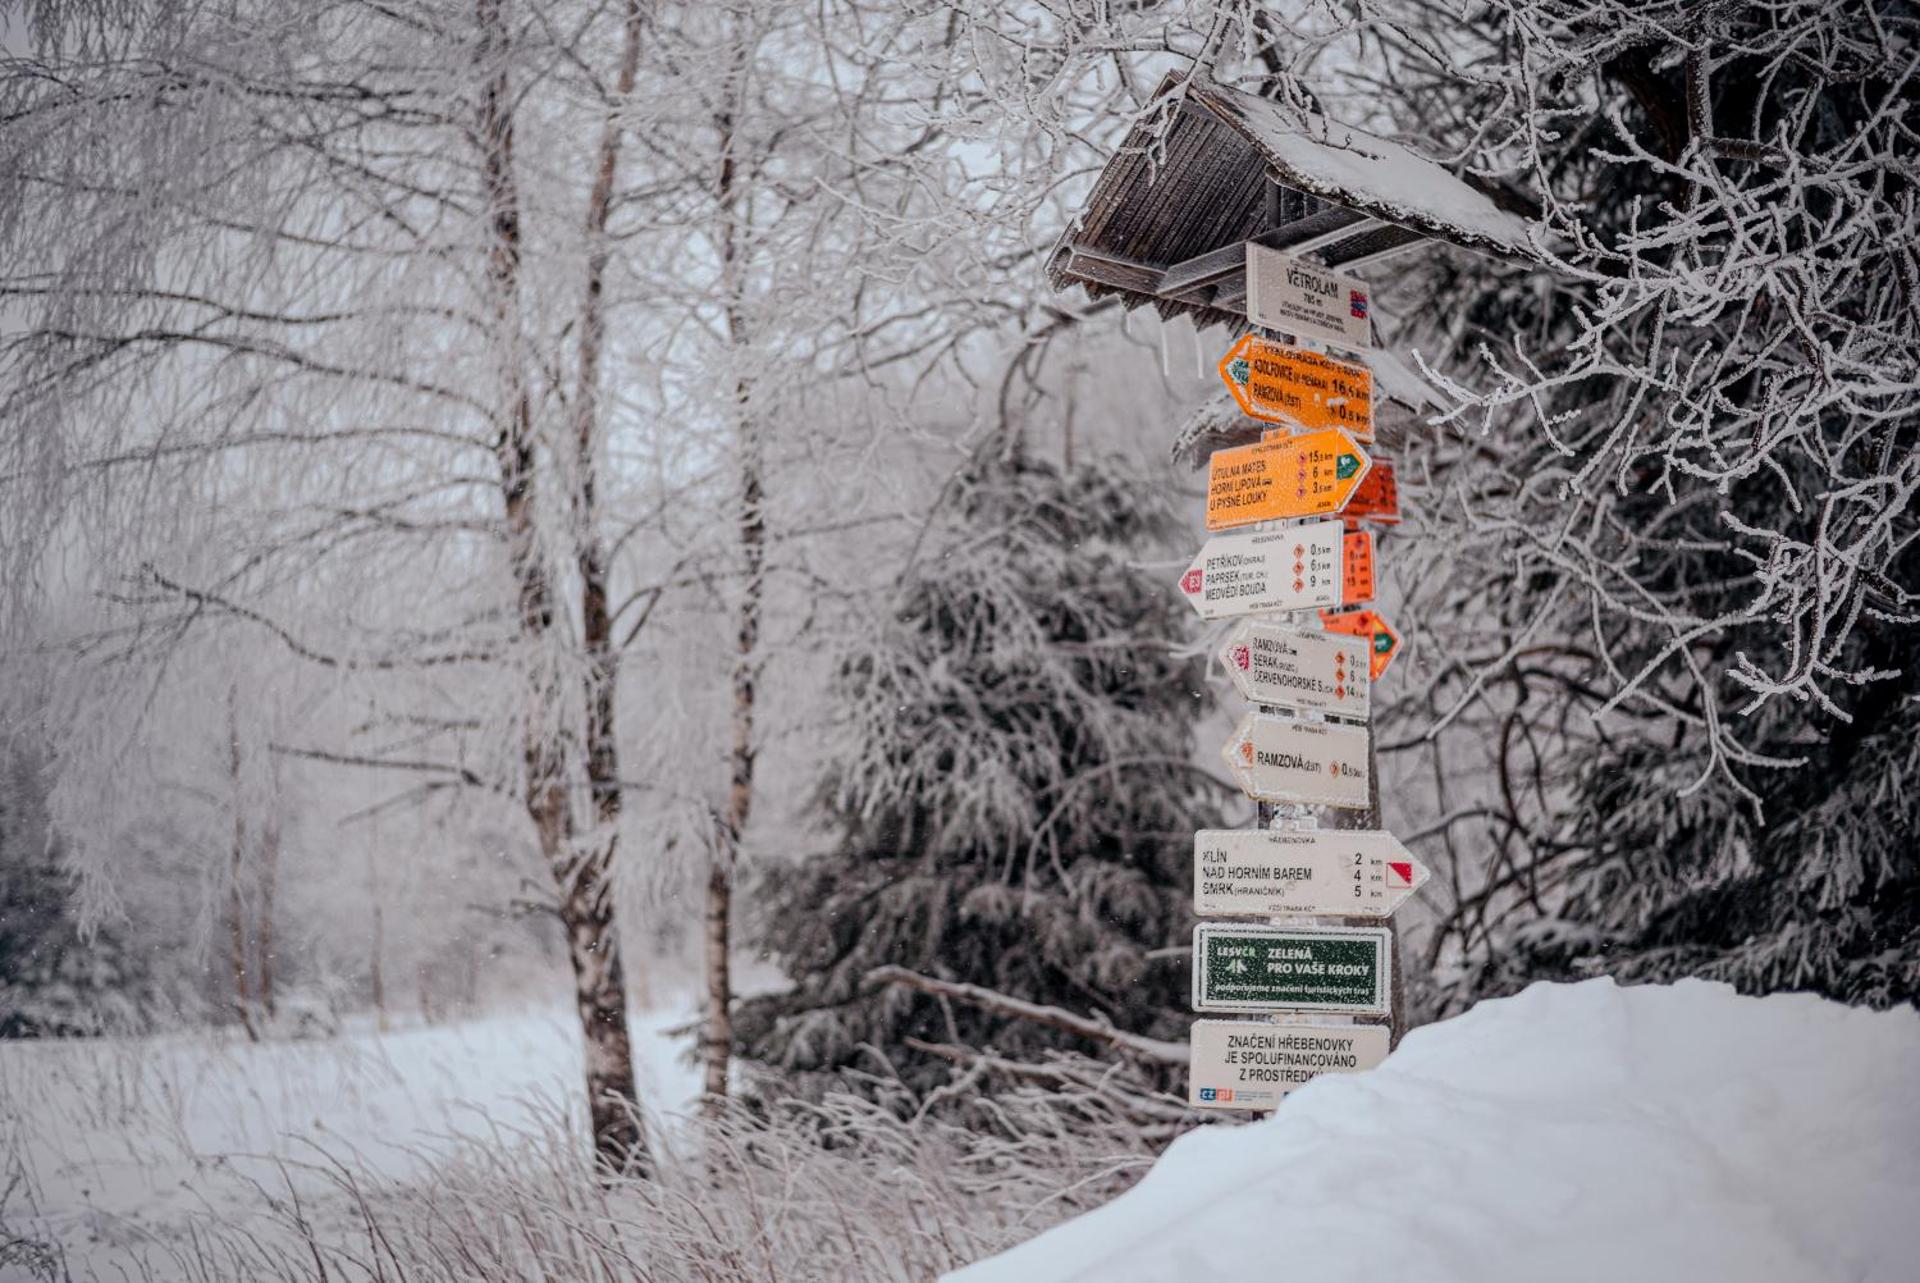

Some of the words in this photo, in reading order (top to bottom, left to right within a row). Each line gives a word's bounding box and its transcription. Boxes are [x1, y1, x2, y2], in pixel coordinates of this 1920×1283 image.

[1286, 266, 1339, 299] VĚTROLAM
[1240, 581, 1267, 597] BOUDA
[1257, 750, 1304, 769] RAMZOVÁ
[1354, 853, 1362, 865] 2
[1370, 858, 1383, 866] km
[1202, 867, 1225, 879] NAD
[1227, 863, 1271, 880] HORNÍM
[1273, 867, 1312, 881] BAREM
[1354, 869, 1362, 882] 4
[1354, 885, 1362, 898] 5
[1370, 890, 1383, 898] km
[1267, 946, 1313, 960] ZELENÁ
[1267, 963, 1292, 974] PRO
[1295, 961, 1325, 975] VAŠE
[1328, 964, 1370, 977] KROKY
[1215, 983, 1270, 993] podporujeme
[1271, 983, 1303, 993] značení
[1227, 1033, 1276, 1049] ZNAČENÍ
[1278, 1034, 1354, 1052] HŘEBENOVKY
[1225, 1052, 1238, 1065] JE
[1241, 1050, 1357, 1068] SPOLUFINANCOVÁNO
[1239, 1068, 1247, 1081] Z
[1249, 1067, 1324, 1083] PROSTŘEDK
